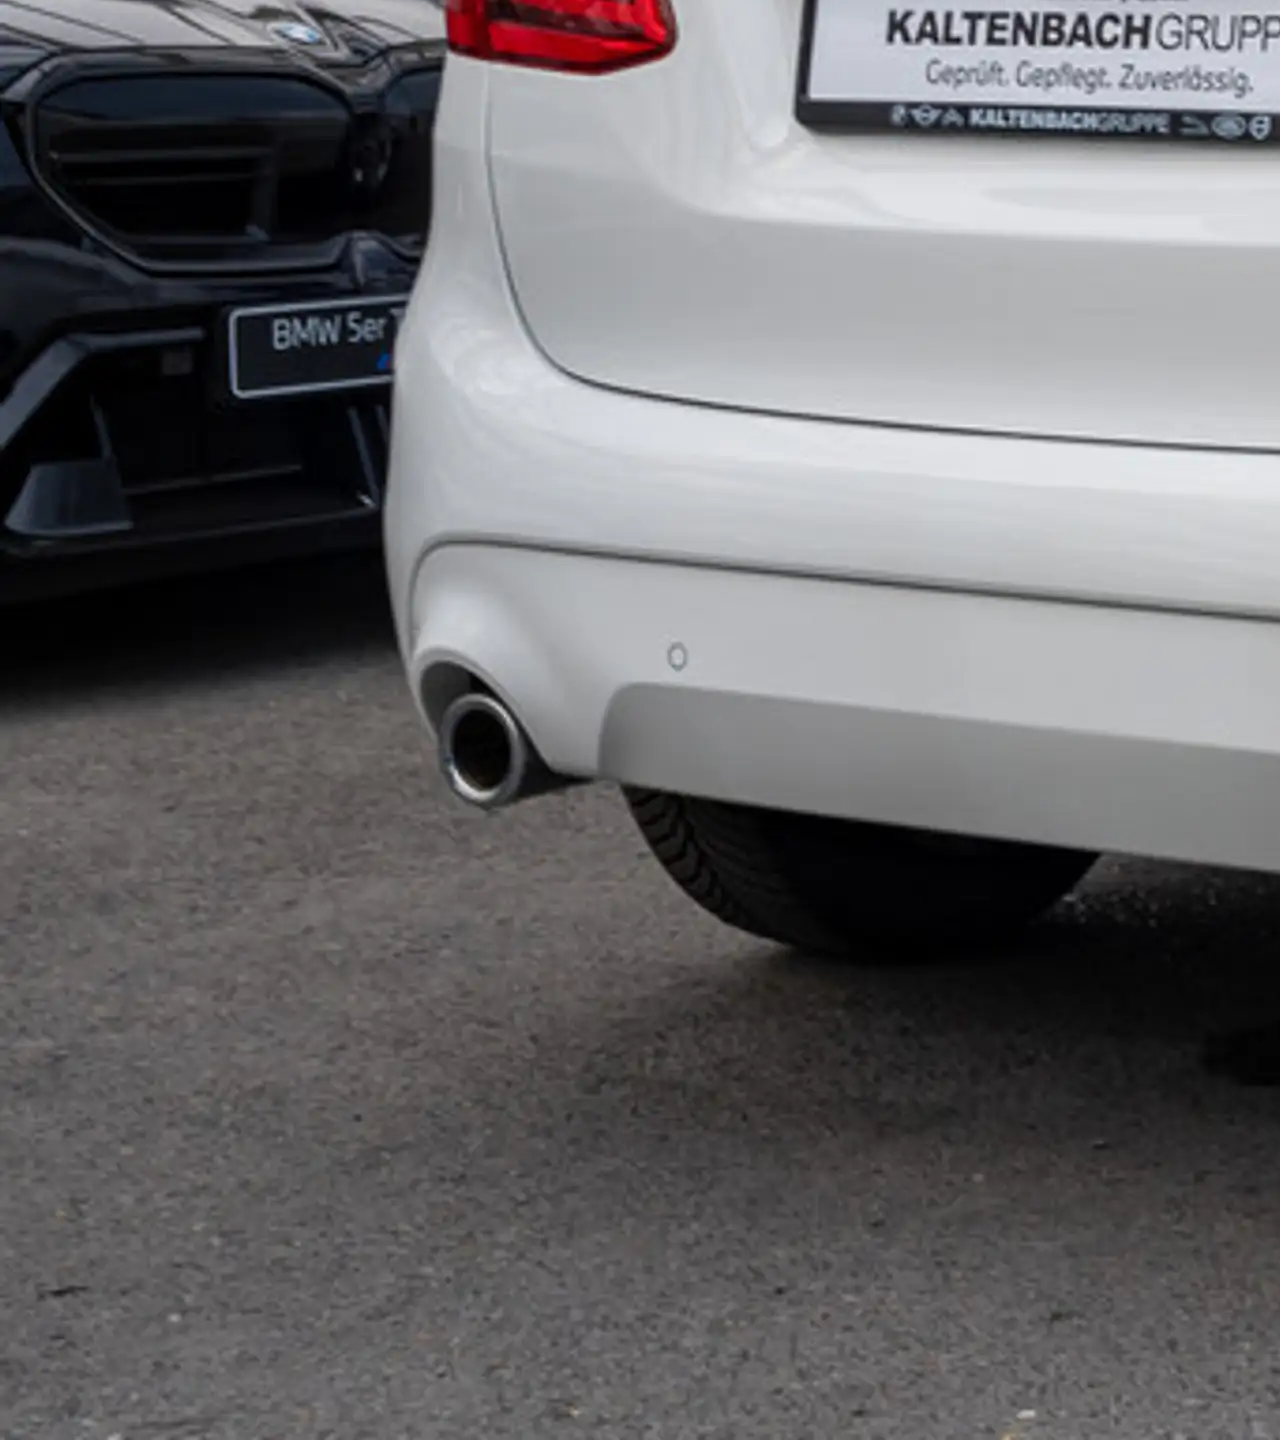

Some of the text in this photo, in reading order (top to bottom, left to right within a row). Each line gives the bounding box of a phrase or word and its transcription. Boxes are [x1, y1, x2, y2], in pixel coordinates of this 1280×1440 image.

[925, 58, 1254, 98] Geprüft. Gepflegt. Zuverlässig.
[273, 314, 343, 350] BMW
[346, 311, 387, 343] 5er
